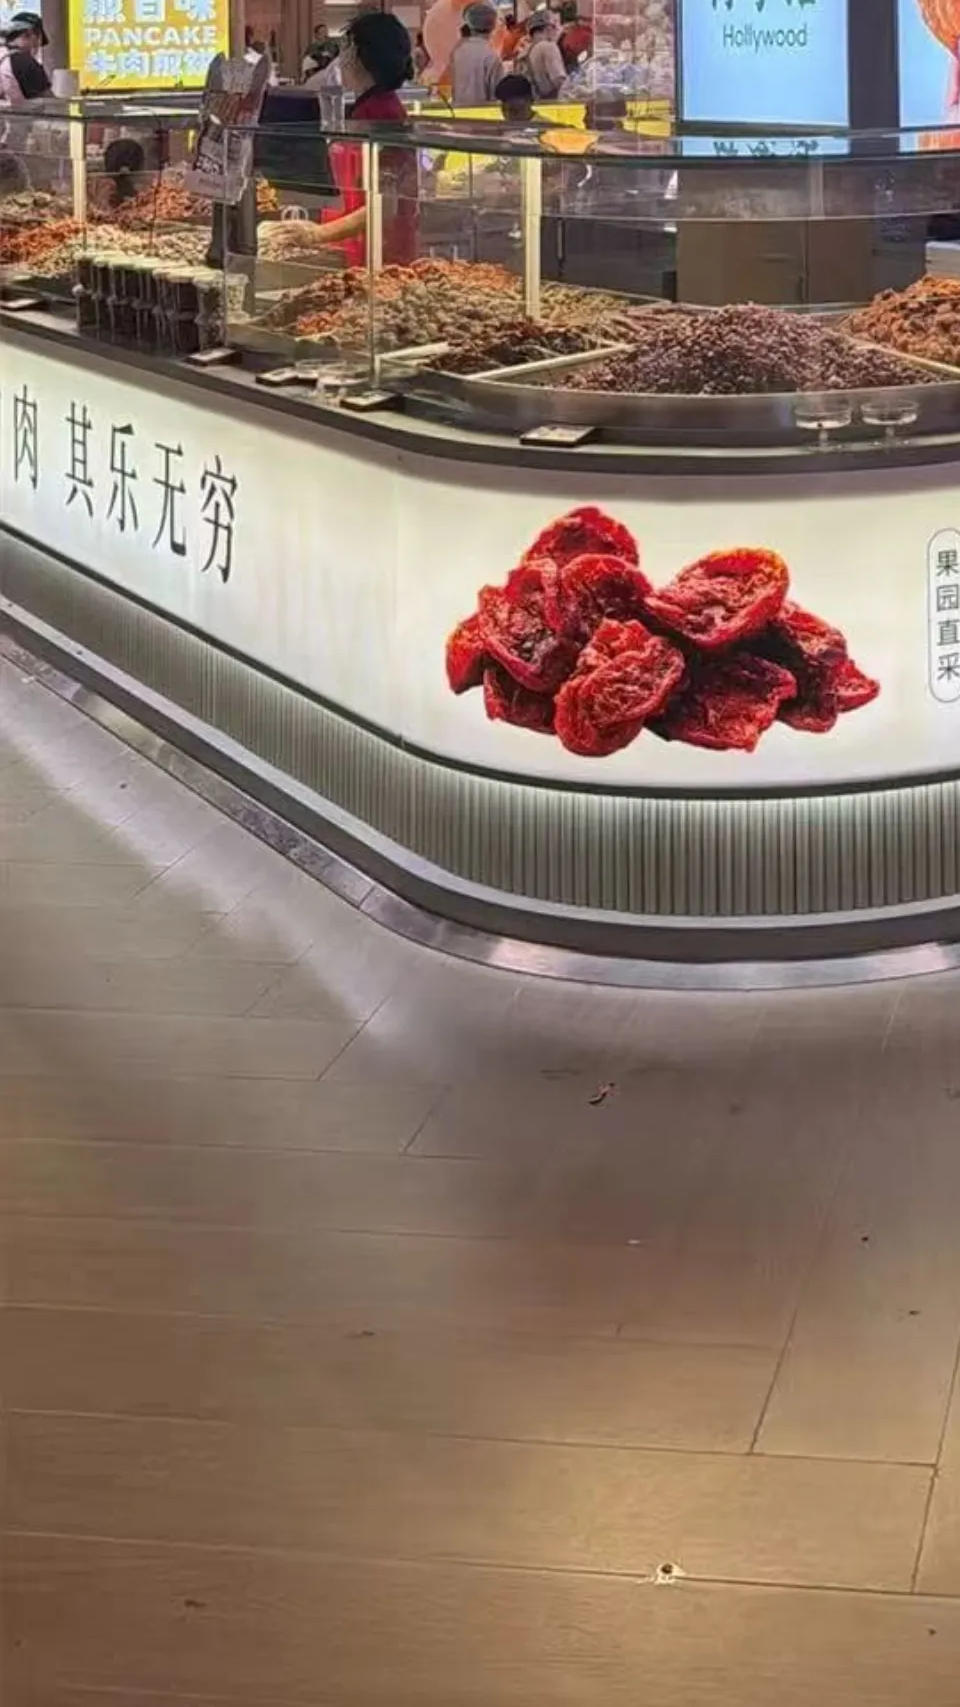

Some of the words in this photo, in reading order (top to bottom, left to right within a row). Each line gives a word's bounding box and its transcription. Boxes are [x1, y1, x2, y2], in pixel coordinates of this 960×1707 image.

[84, 26, 218, 46] PANCAKE
[722, 23, 808, 54] Hollywood
[12, 384, 39, 490] 肉
[65, 400, 239, 584] 其乐无穷
